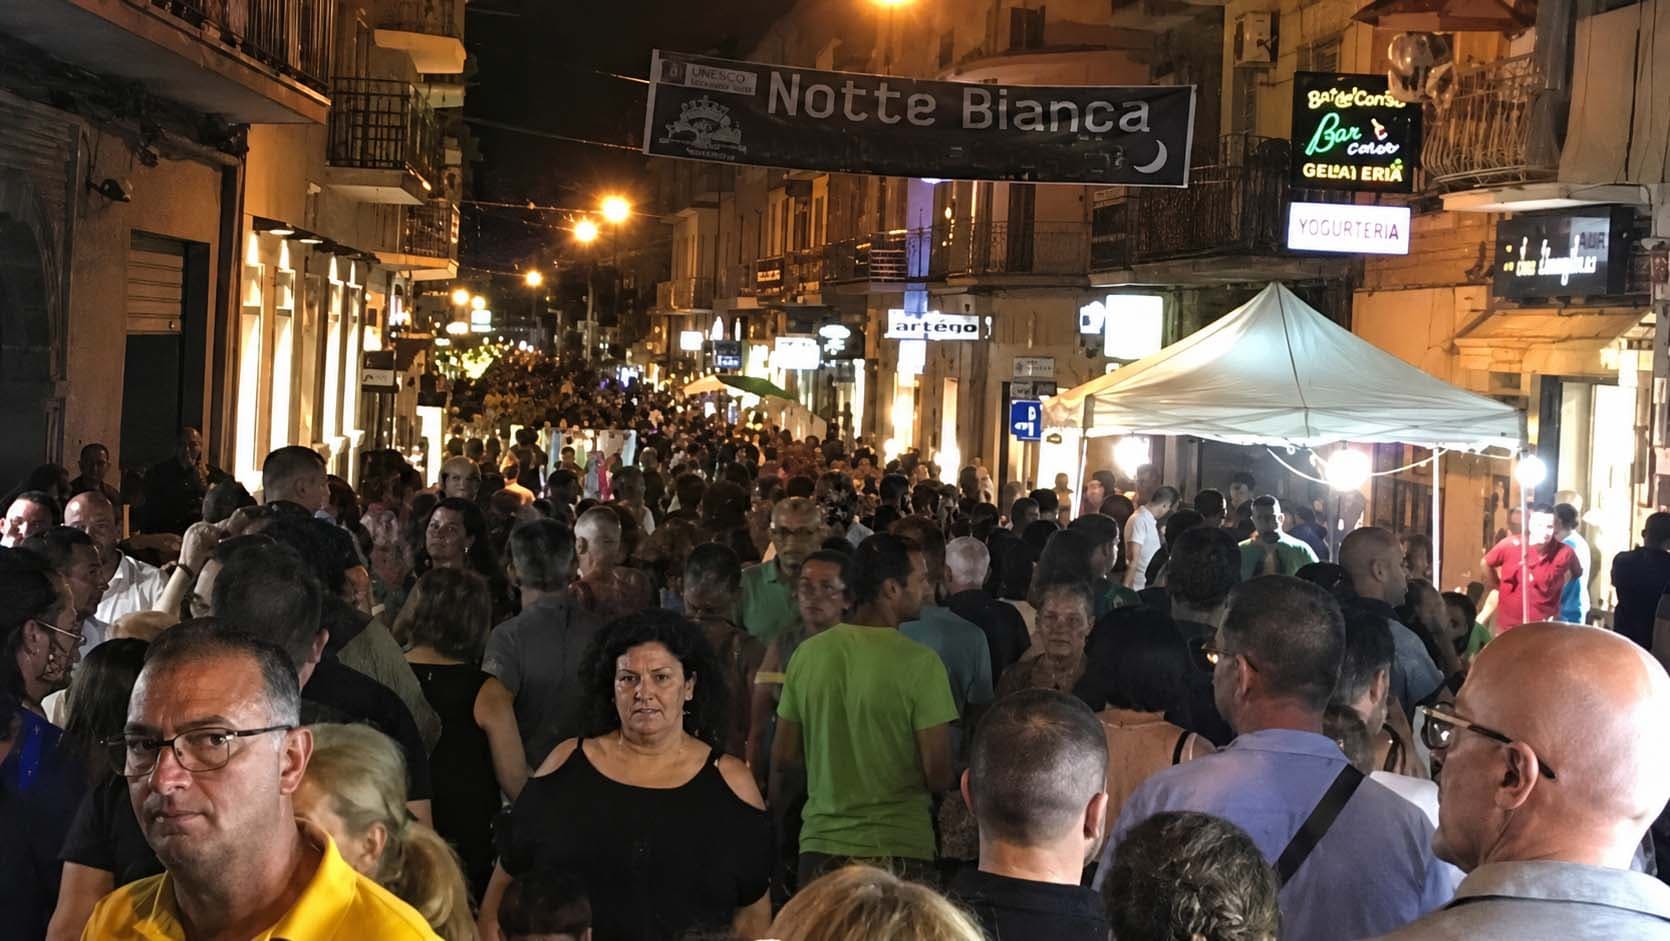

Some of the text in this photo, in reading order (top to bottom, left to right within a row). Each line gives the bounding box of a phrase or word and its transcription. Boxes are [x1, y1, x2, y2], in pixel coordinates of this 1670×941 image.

[692, 66, 746, 84] UNESCO
[767, 71, 1151, 133] Notte Bianca
[1304, 111, 1362, 156] Bar
[1299, 218, 1399, 240] YOGURTERIA
